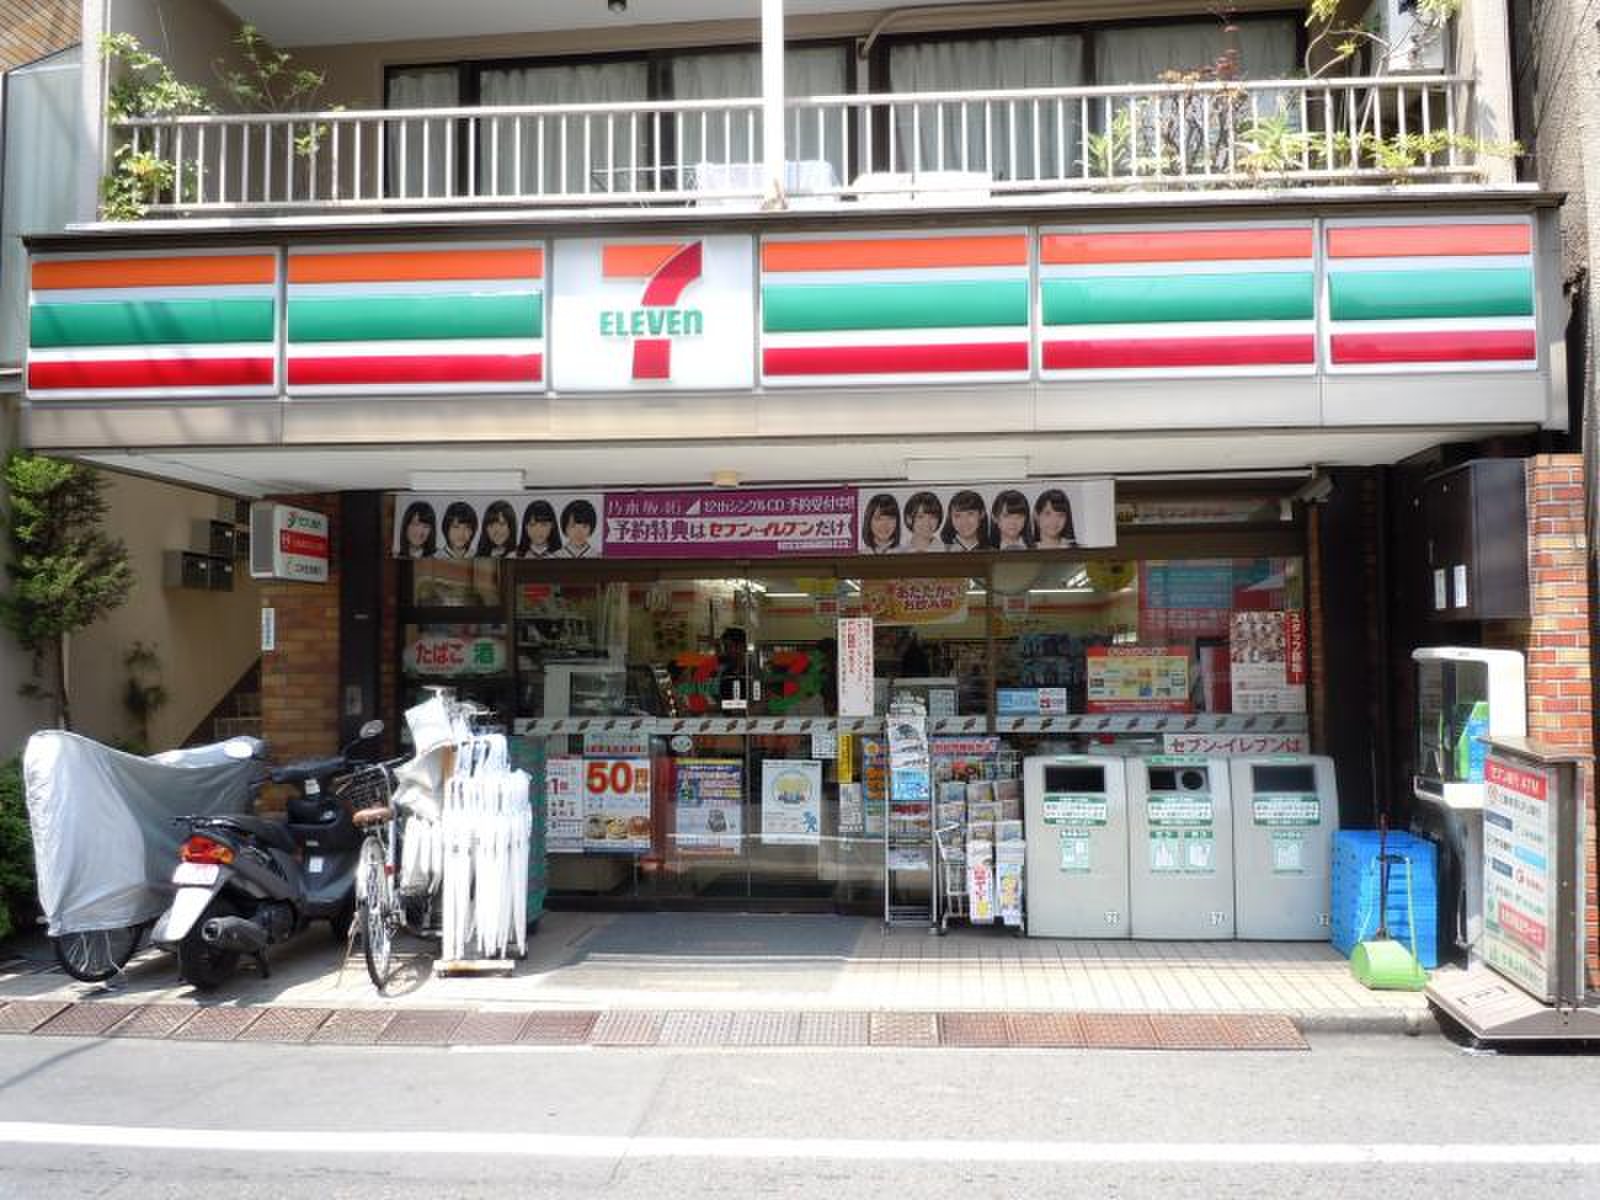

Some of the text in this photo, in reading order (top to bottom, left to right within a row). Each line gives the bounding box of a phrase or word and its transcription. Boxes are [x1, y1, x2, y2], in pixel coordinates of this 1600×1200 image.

[602, 240, 702, 379] 7
[415, 641, 465, 665] たばこ
